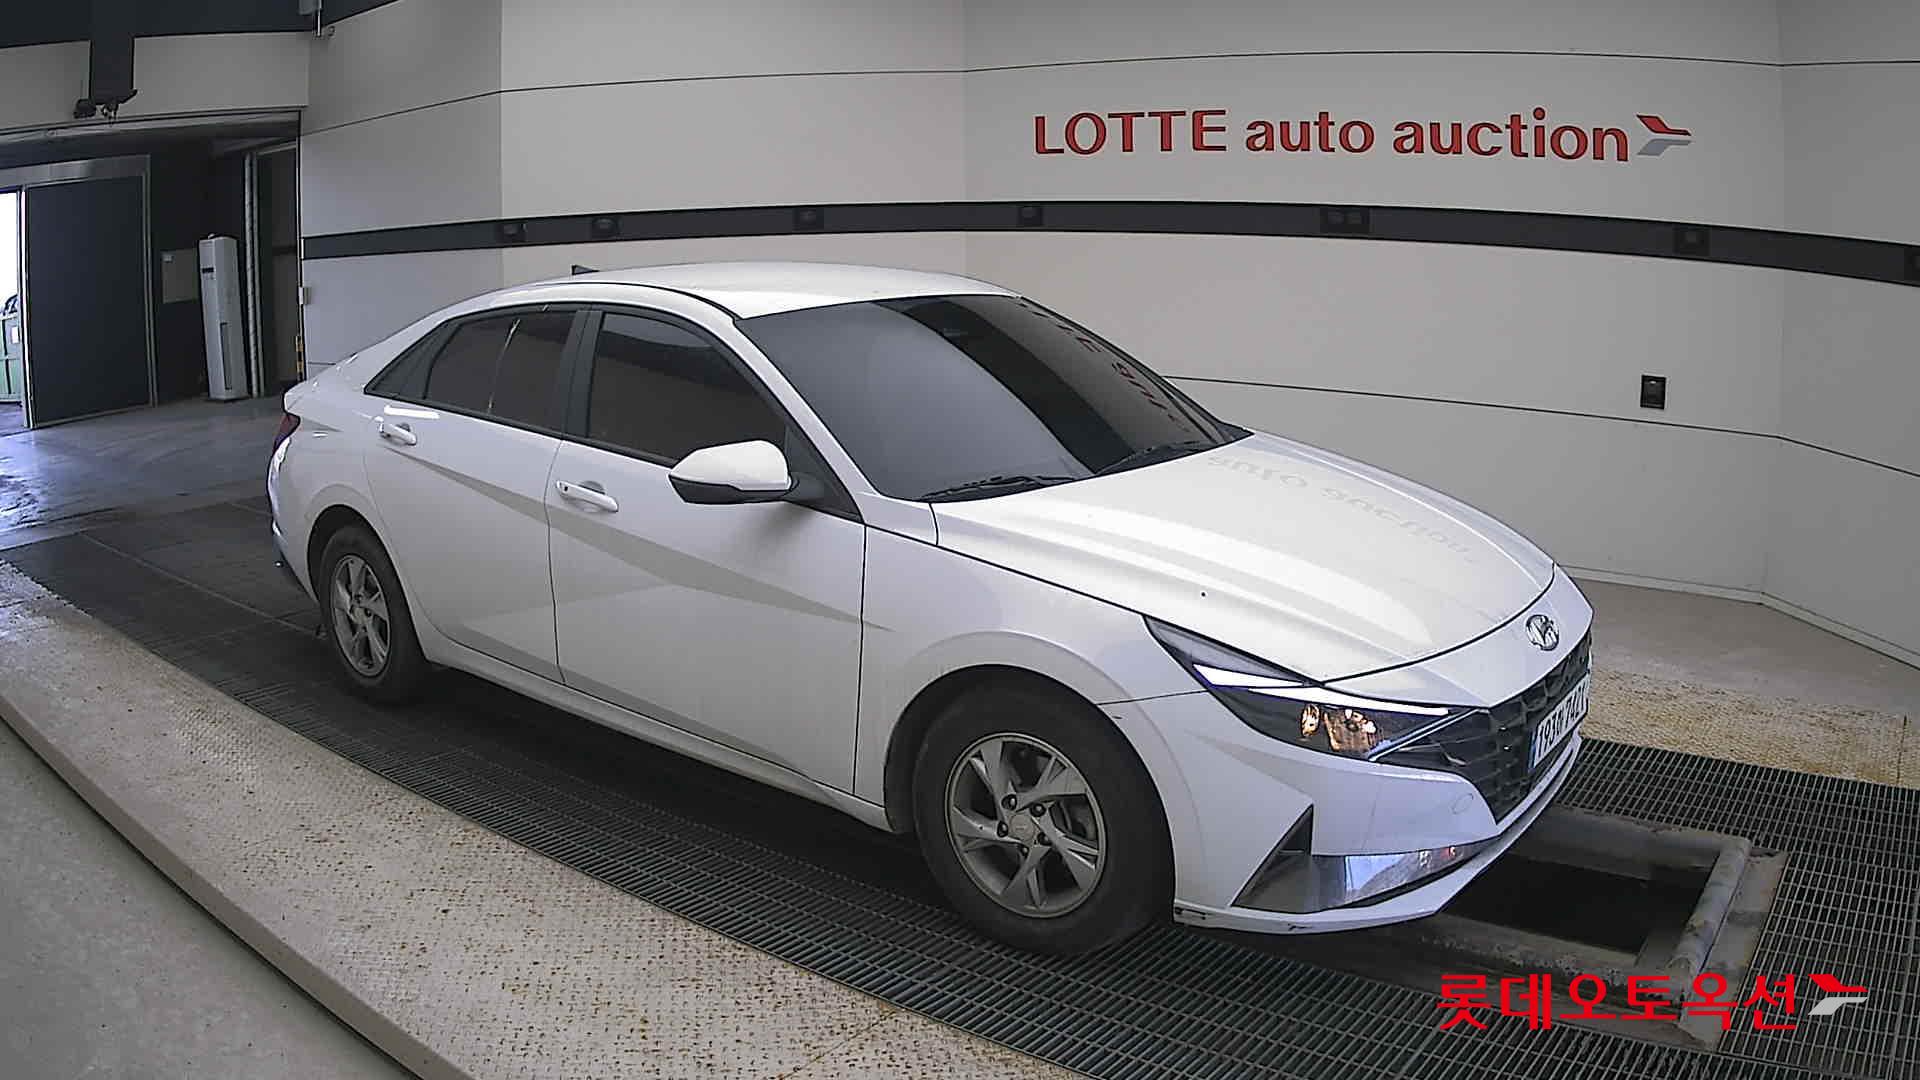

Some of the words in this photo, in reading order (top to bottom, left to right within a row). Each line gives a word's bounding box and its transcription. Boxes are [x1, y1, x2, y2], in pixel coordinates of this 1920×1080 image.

[1034, 110, 1227, 155] LOTTE
[1245, 111, 1375, 153] auto
[1392, 106, 1629, 162] auction
